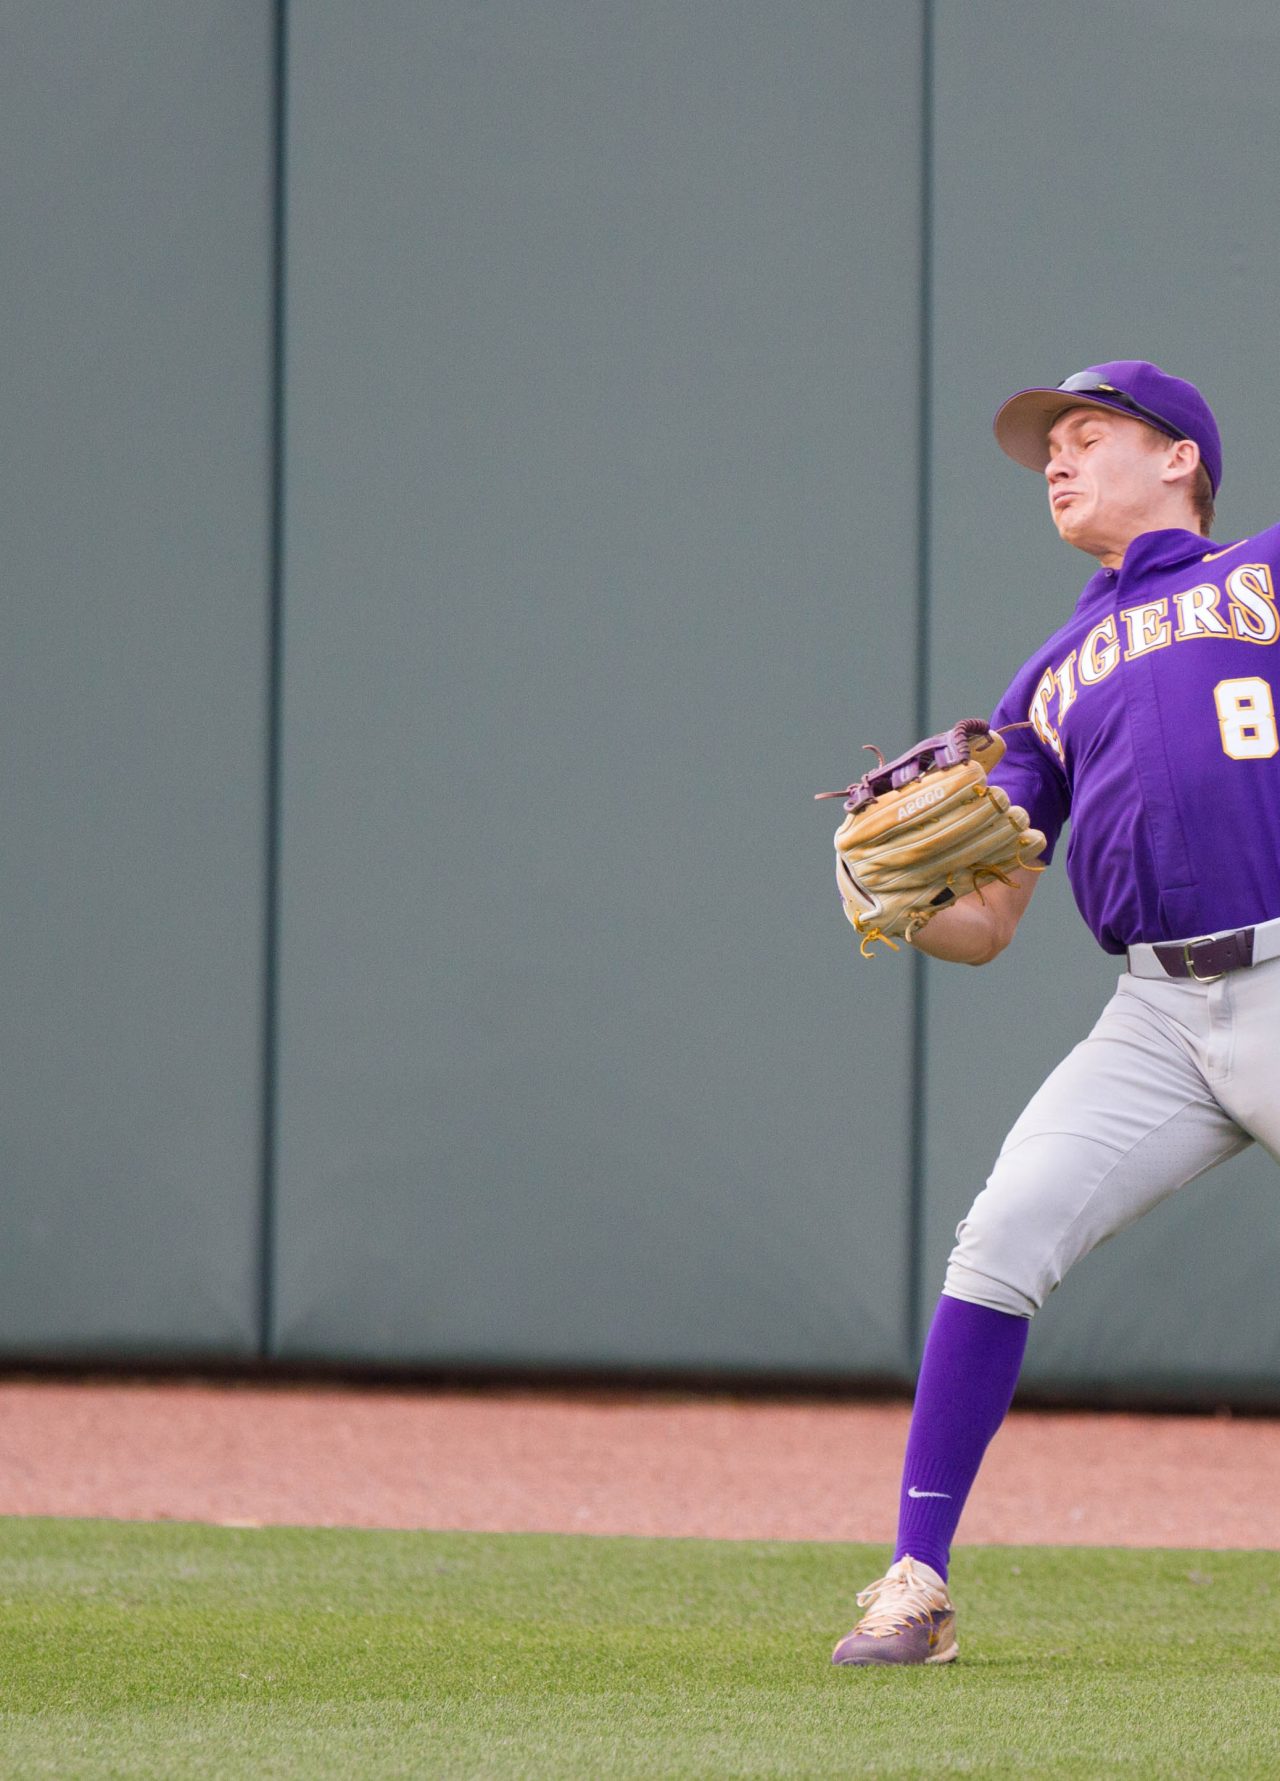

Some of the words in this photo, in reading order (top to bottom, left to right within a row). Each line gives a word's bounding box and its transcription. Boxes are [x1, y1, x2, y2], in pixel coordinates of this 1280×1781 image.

[1029, 563, 1280, 763] TIGERS
[1213, 676, 1280, 761] 8
[896, 786, 946, 821] A2000
